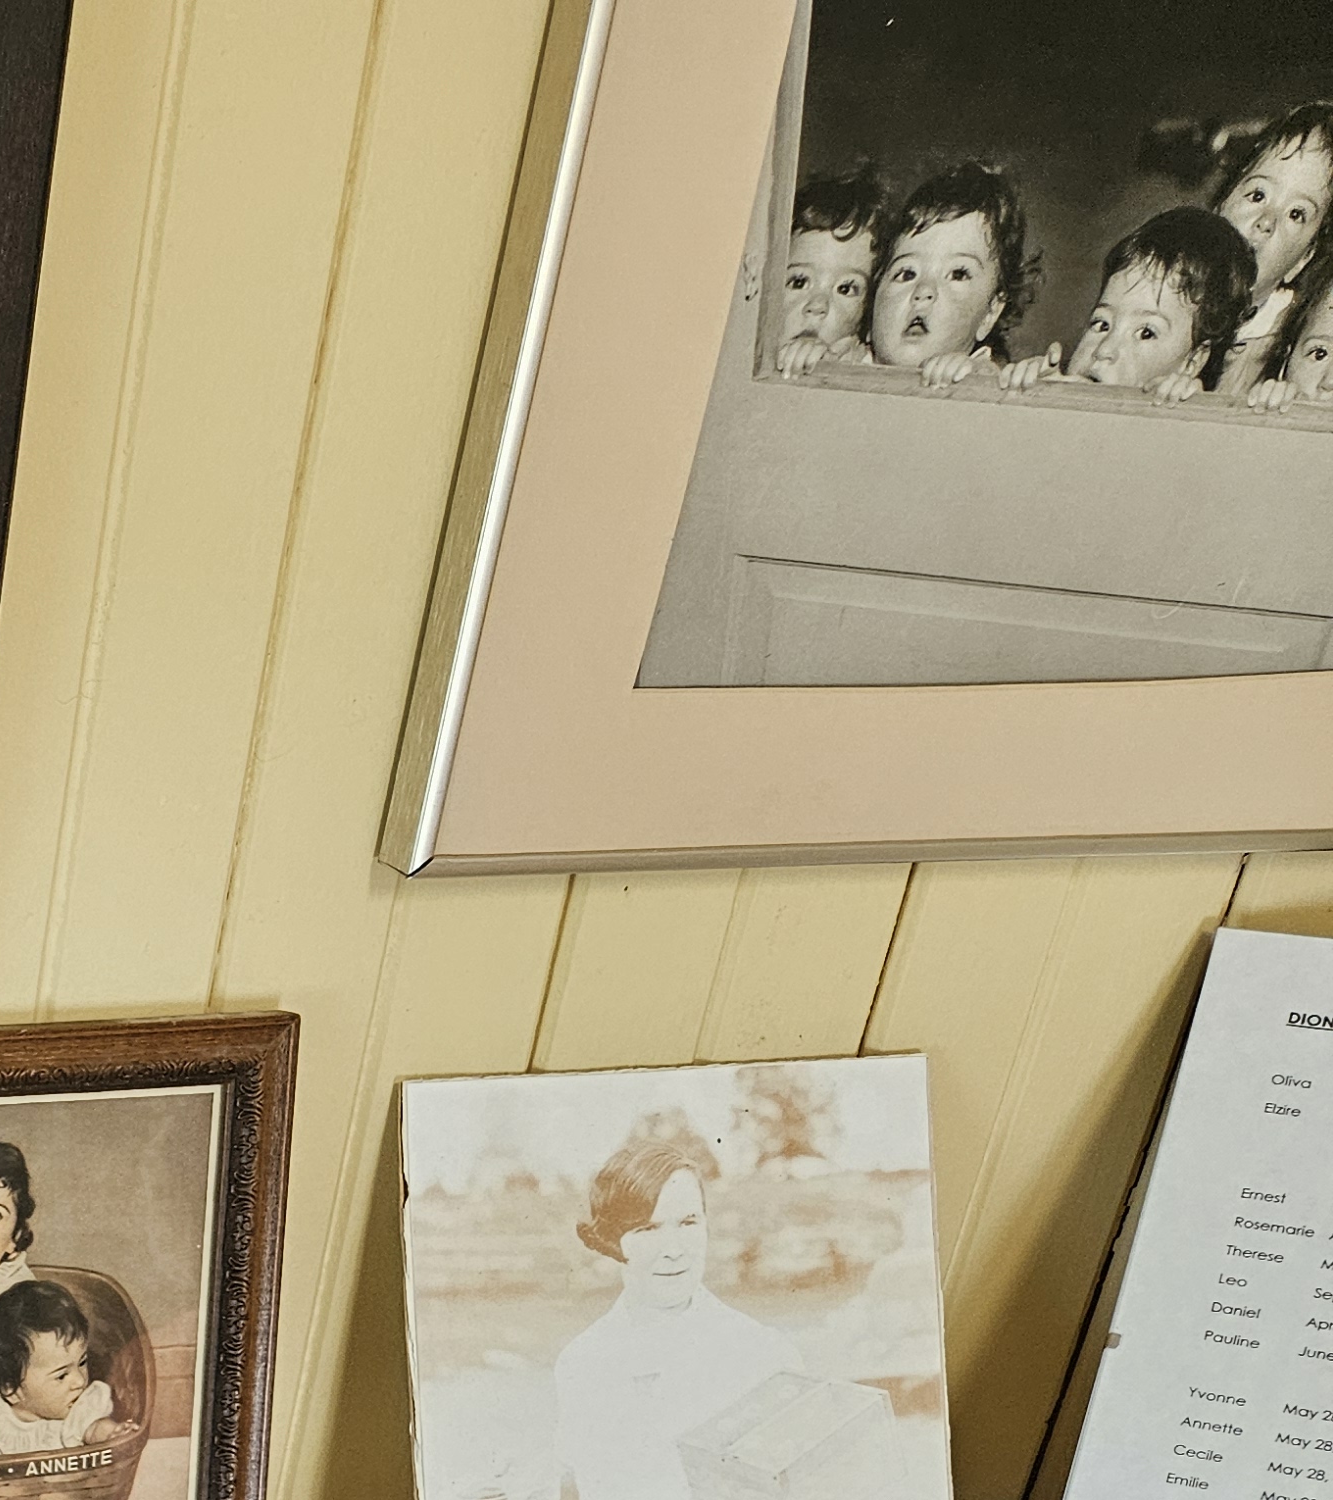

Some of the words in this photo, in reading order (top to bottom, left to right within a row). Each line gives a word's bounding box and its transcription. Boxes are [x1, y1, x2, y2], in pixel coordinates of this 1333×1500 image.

[1271, 1073, 1312, 1089] Oliva
[1263, 1102, 1301, 1117] Elzire
[1240, 1187, 1286, 1204] Ernest
[1234, 1216, 1315, 1238] Rosemarie
[1226, 1244, 1284, 1263] Therese
[1218, 1273, 1248, 1288] Leo
[1210, 1301, 1262, 1319] Daniel
[1203, 1330, 1260, 1349] Pauline
[1298, 1346, 1333, 1361] June
[1189, 1386, 1247, 1407] Yvonne
[1282, 1403, 1319, 1420] May
[1180, 1416, 1244, 1436] Annette
[1274, 1432, 1312, 1450] May
[1314, 1438, 1333, 1452] 28
[25, 1449, 113, 1476] ANNETTE
[1173, 1444, 1223, 1463] Cecile
[1266, 1461, 1303, 1479] May
[1306, 1468, 1329, 1483] 28,
[1165, 1472, 1209, 1490] Emilie
